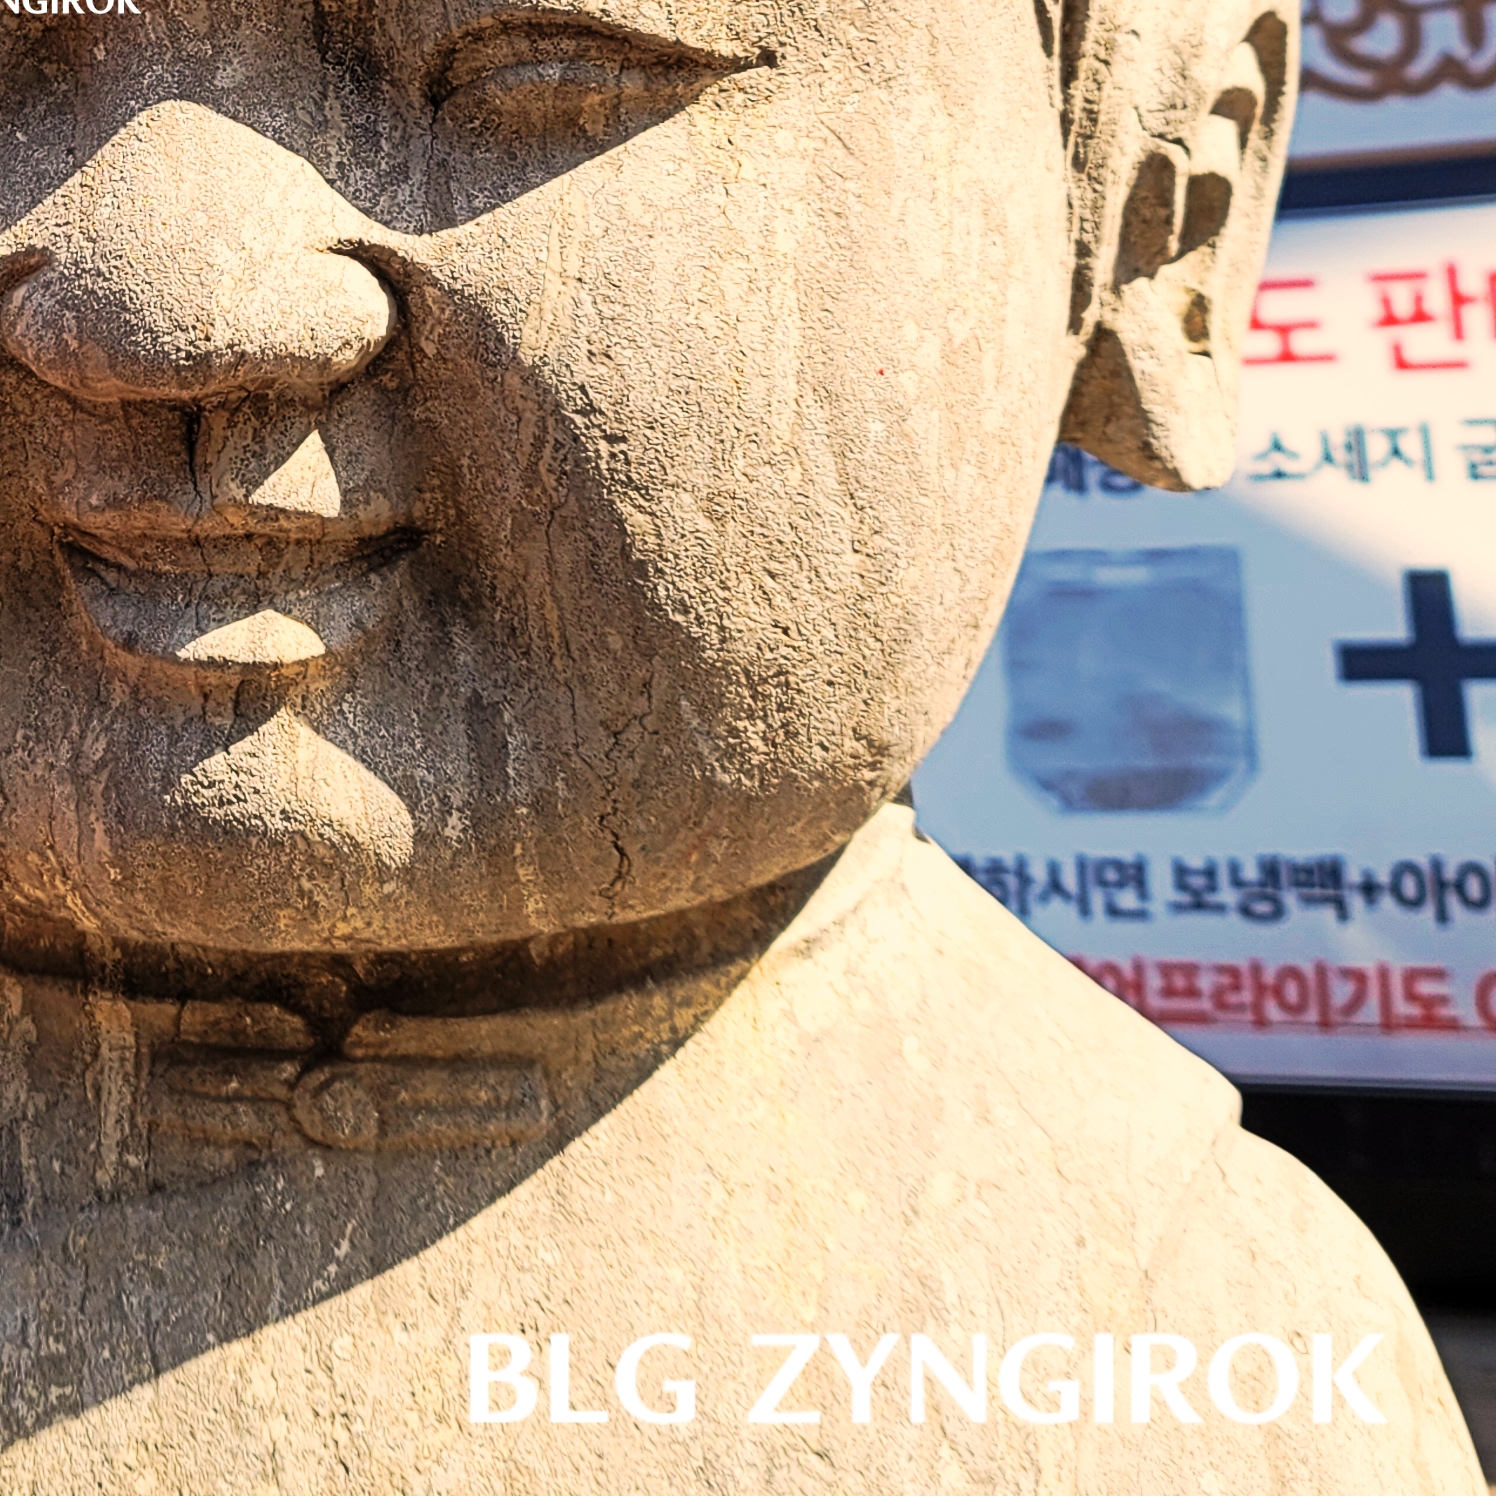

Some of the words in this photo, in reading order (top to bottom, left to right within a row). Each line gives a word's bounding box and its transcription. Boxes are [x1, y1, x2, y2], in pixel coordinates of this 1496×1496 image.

[1367, 260, 1496, 371] 판
[1248, 420, 1436, 483] 소세지
[954, 852, 1153, 922] 하시면
[1065, 953, 1461, 1032] 어프라이기도
